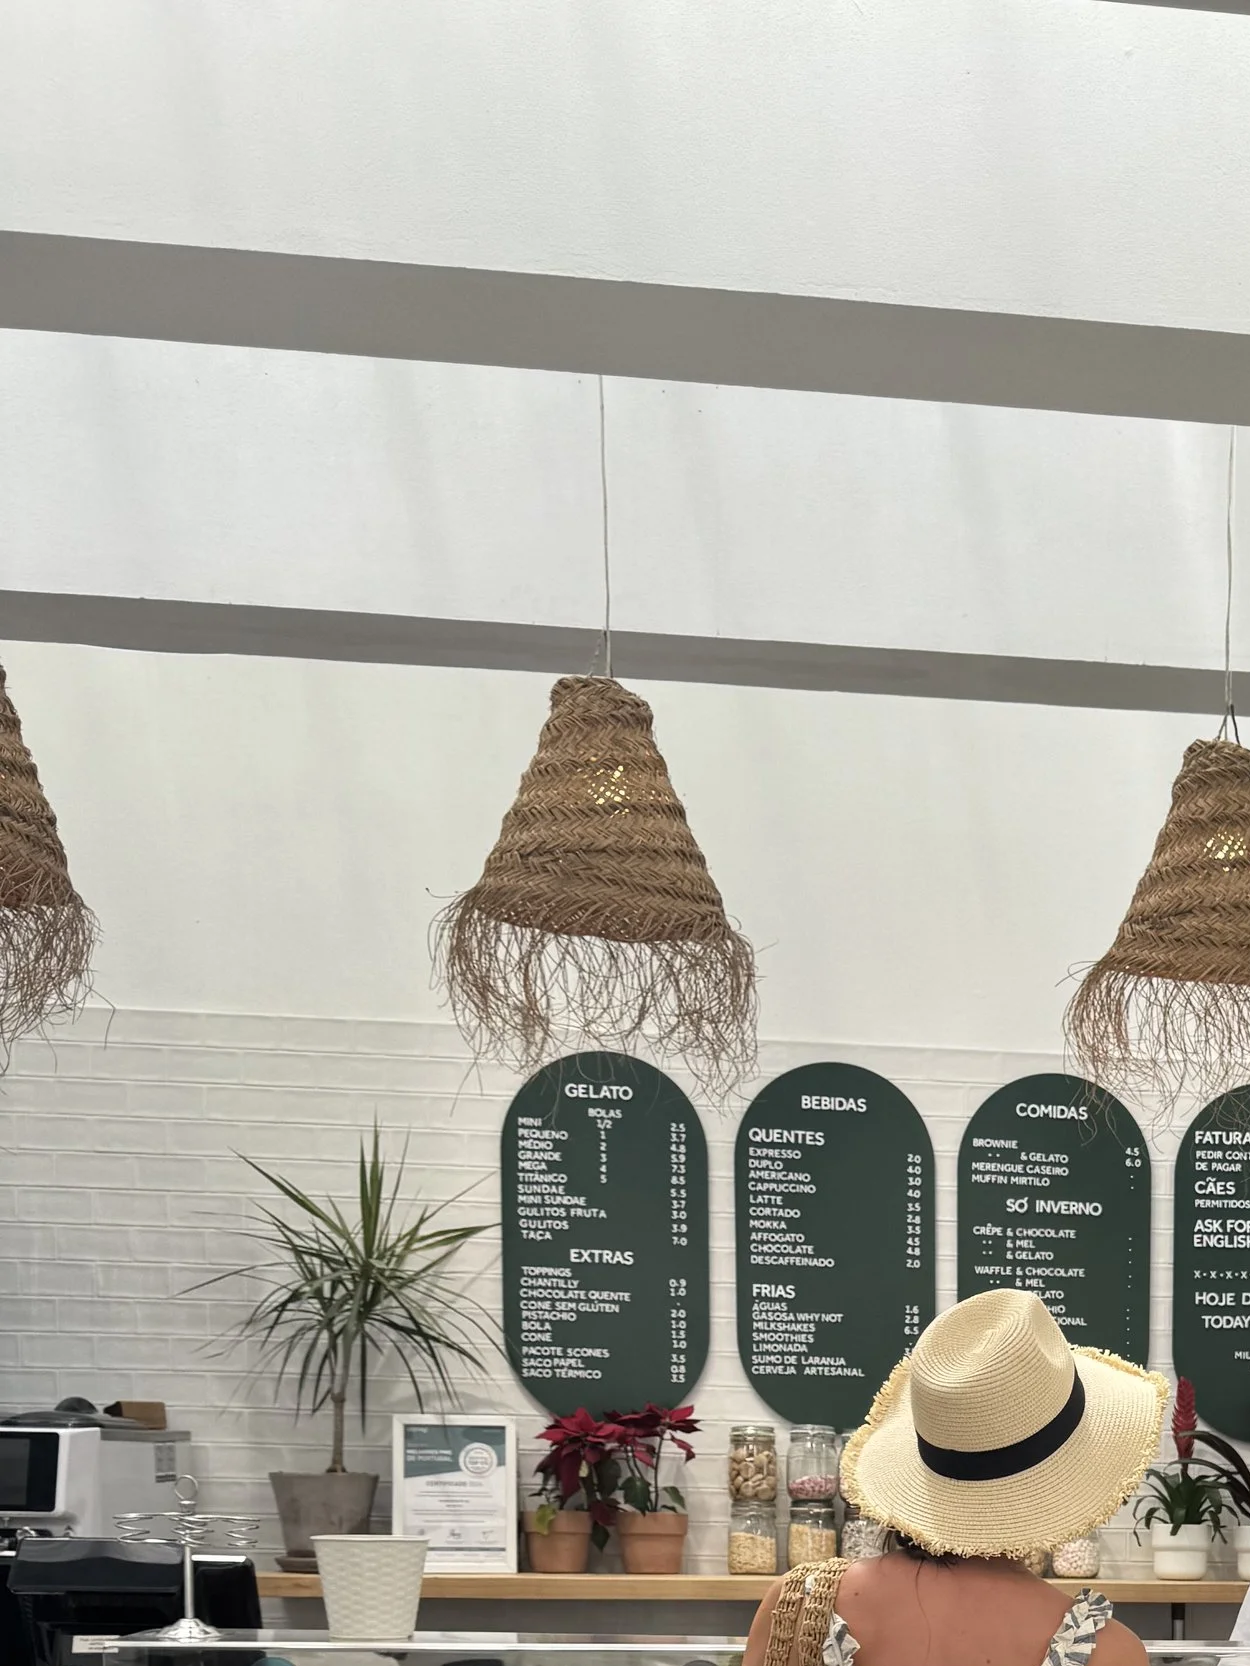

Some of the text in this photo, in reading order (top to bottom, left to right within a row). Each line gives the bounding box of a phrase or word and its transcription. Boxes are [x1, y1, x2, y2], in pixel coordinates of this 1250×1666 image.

[565, 1083, 633, 1100] GELATO
[801, 1095, 867, 1112] BEBIDAS
[588, 1108, 622, 1118] BOLAS
[1016, 1103, 1088, 1120] COMIDAS
[518, 1117, 542, 1127] MINI
[518, 1128, 568, 1140] PEQUENO
[601, 1131, 606, 1139] 1
[748, 1128, 825, 1146] QUENTES
[518, 1139, 607, 1150] MÉDIO 2
[973, 1138, 1139, 1156] BROWNIE 4.5
[518, 1152, 562, 1161] GRANDE
[600, 1154, 607, 1162] 3
[749, 1147, 801, 1159] EXPRESSO
[1196, 1151, 1222, 1159] PEDIR
[749, 1159, 783, 1170] DUPLO
[1020, 1152, 1141, 1167] & GELATO 6.0
[518, 1162, 547, 1170] MEGA
[972, 1162, 1069, 1176] MERENGUE CASEIRO
[1195, 1162, 1242, 1172] DE PAGAR
[517, 1172, 607, 1183] TITÂNICO 5
[749, 1170, 811, 1182] AMERICANO
[972, 1175, 1050, 1186] MUFFIN MIRTILO
[517, 1185, 565, 1195] SUNDAE
[748, 1182, 816, 1193] CAPPUCCINO
[1195, 1177, 1235, 1195] CÃES
[518, 1196, 587, 1206] MINI SUNDAE
[750, 1195, 783, 1205] LATTE
[1195, 1199, 1250, 1209] PERMITIDOS
[1006, 1197, 1102, 1216] SÓ INVERNO
[517, 1207, 607, 1218] GULITOS FRUTA
[749, 1207, 800, 1218] CORTADO
[519, 1219, 569, 1230] GULITOS
[749, 1220, 787, 1230] MOKKA
[1194, 1219, 1223, 1233] ASK
[521, 1231, 552, 1241] TAÇA
[973, 1223, 1076, 1239] CRÊPE & CHOCOLATE
[750, 1232, 804, 1242] AFFOGATO
[750, 1243, 814, 1255] CHOCOLATE
[1007, 1240, 1035, 1248] & MEL
[570, 1249, 634, 1265] EXTRAS
[750, 1255, 835, 1267] DESCAFFEINADO
[1007, 1251, 1054, 1260] & GELATO
[521, 1266, 572, 1277] TOPPINGS
[975, 1266, 1085, 1277] WAFFLE & CHOCOLATE
[520, 1277, 579, 1288] CHANTILLY
[1015, 1279, 1045, 1287] & MEL
[520, 1288, 631, 1301] CHOCOLATE QUENTE
[752, 1284, 795, 1298] FRIAS
[1195, 1292, 1235, 1306] HOJE
[520, 1301, 552, 1310] CONE
[555, 1302, 576, 1310] SEM
[905, 1305, 919, 1314] 1.6
[522, 1311, 577, 1321] PISTACHIO
[752, 1312, 919, 1324] GASOSA WHY NOT 2.8
[522, 1321, 552, 1331] BOLA
[753, 1322, 919, 1335] MILKSHAKES 6.5
[521, 1332, 552, 1341] CONE
[753, 1333, 814, 1343] SMOOTHIES
[522, 1347, 610, 1358] PACOTE SCONES
[753, 1344, 808, 1352] LIMONADA
[522, 1358, 585, 1367] SACO PAPEL
[752, 1356, 846, 1365] SUMO DE LARANJA
[522, 1368, 602, 1379] SACO TÉRMICO
[752, 1366, 865, 1377] CERVEJA ARTESANAL
